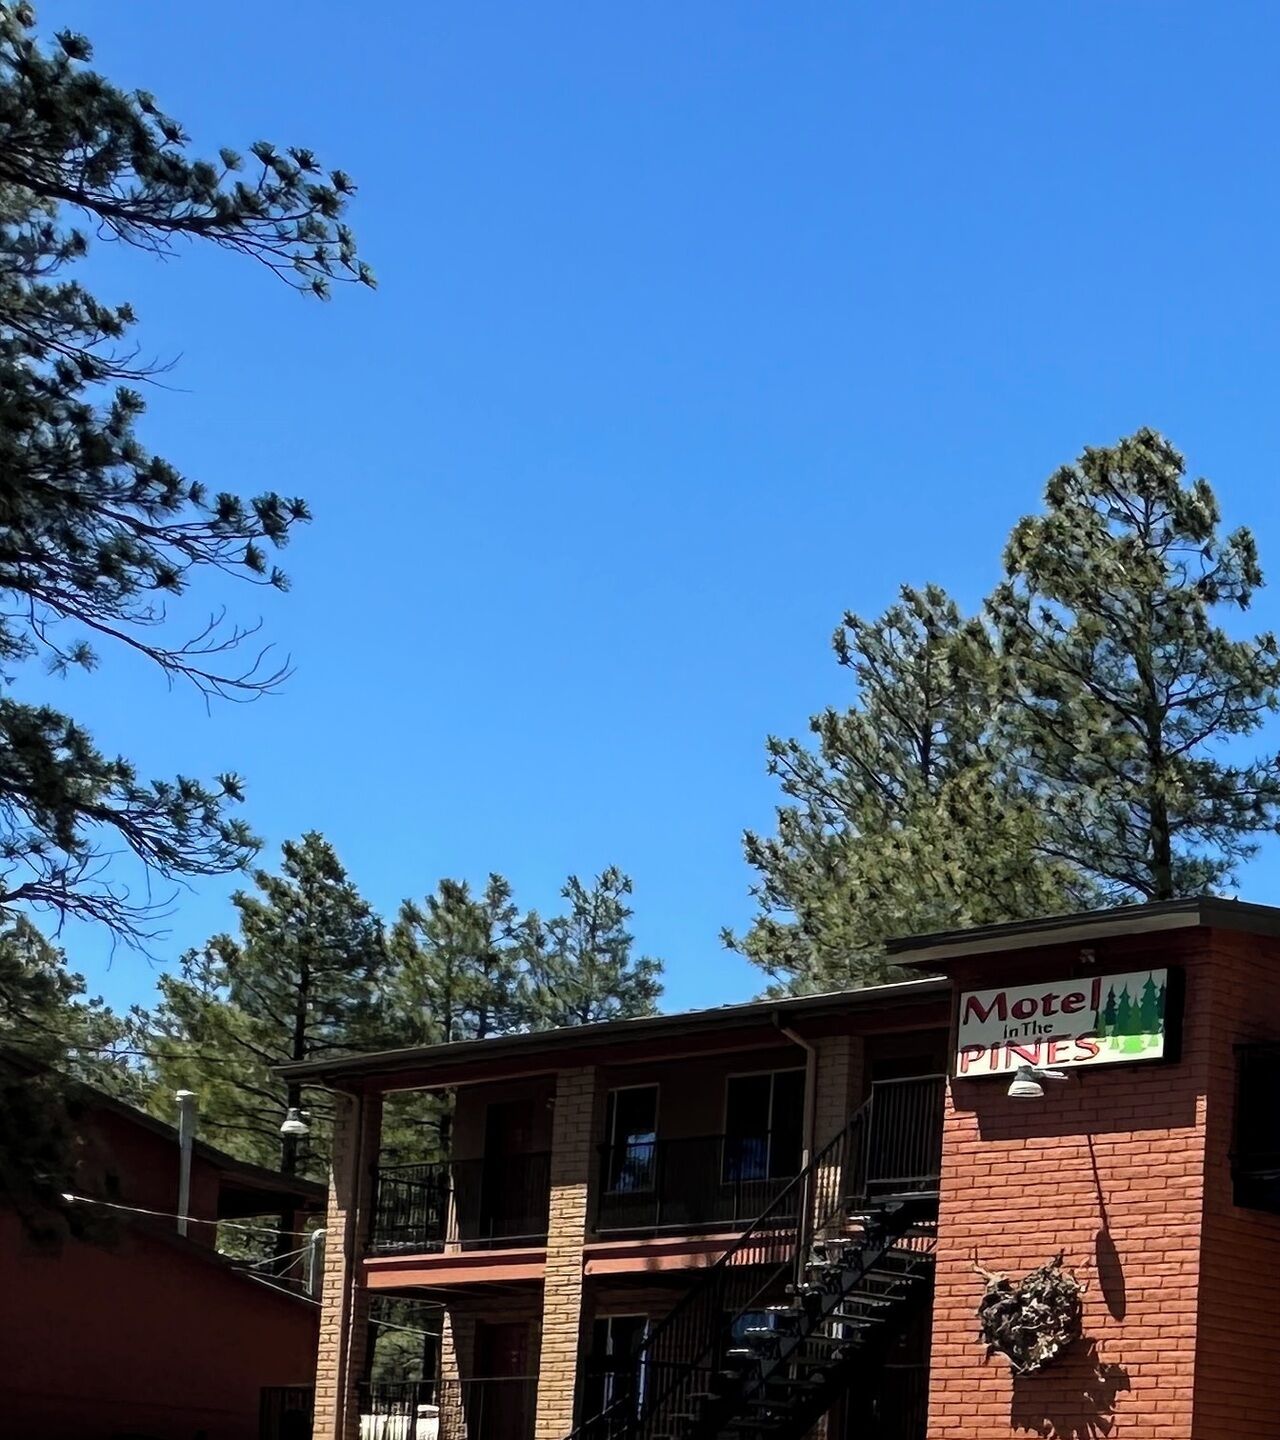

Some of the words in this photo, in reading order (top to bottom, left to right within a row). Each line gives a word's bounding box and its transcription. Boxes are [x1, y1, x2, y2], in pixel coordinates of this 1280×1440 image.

[962, 976, 1102, 1025] Motel
[1021, 1020, 1054, 1036] The
[960, 1031, 1104, 1073] PINES
